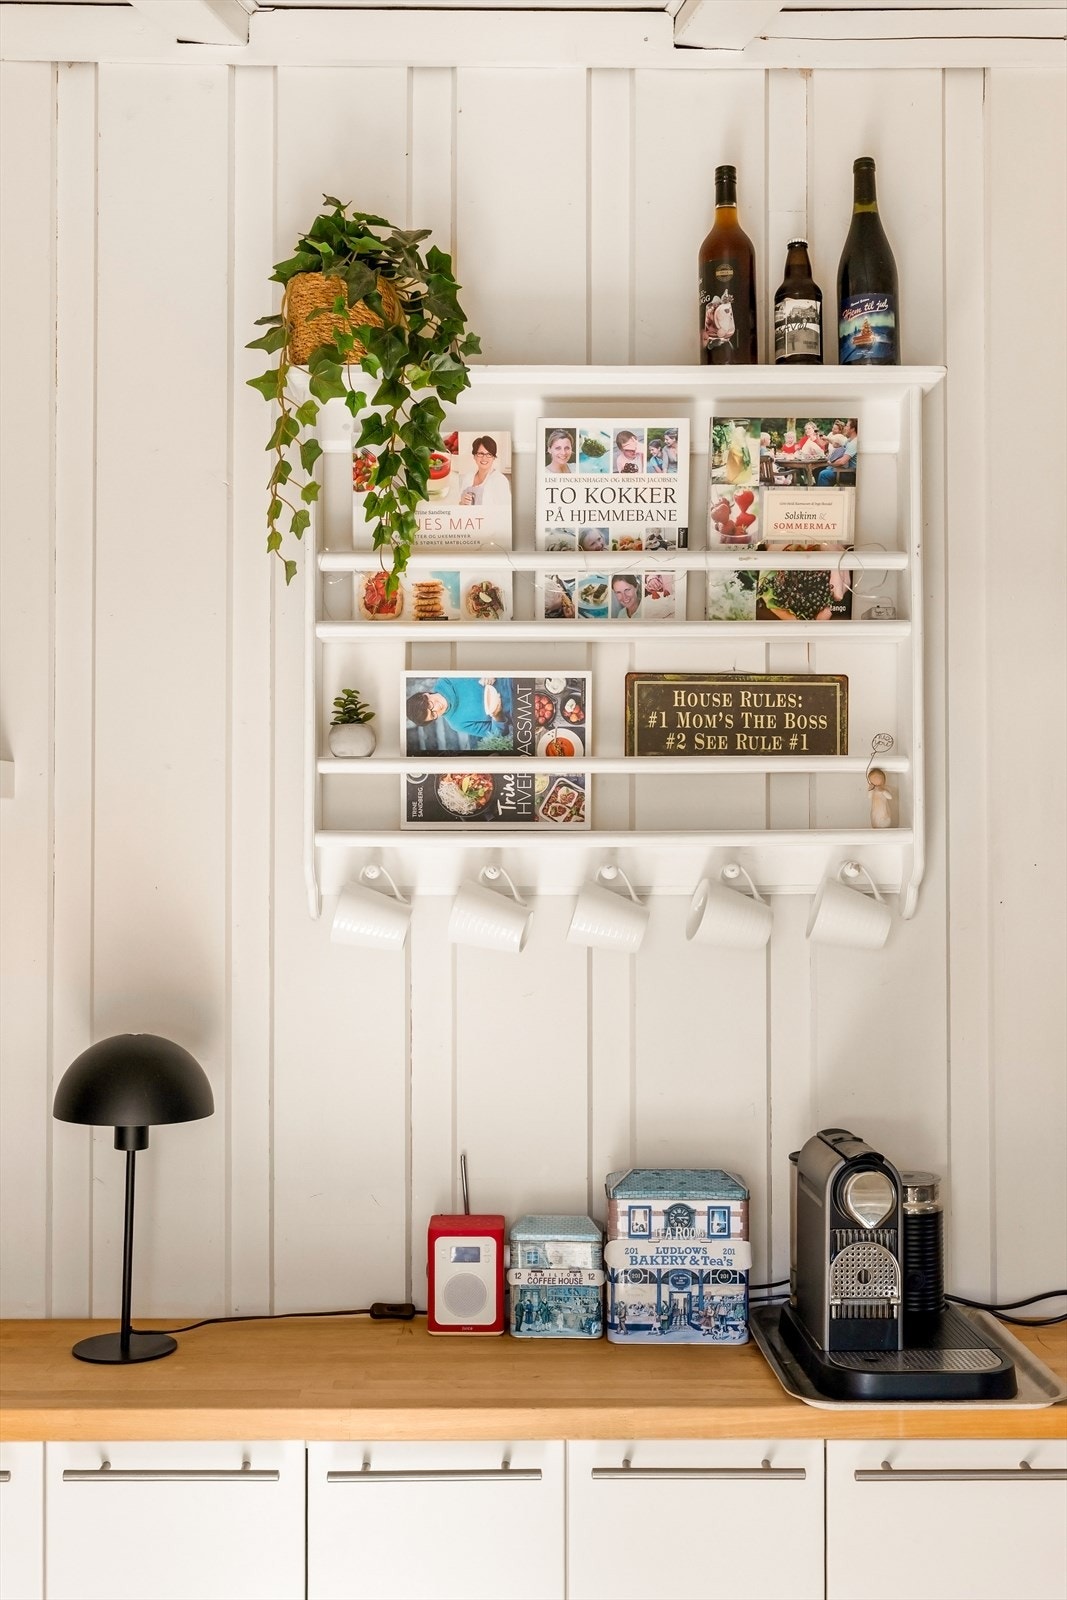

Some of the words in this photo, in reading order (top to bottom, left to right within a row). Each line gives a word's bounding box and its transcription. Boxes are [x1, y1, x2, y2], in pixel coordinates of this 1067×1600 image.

[864, 300, 874, 311] til
[545, 487, 577, 504] TO
[585, 487, 677, 504] KOKKER
[545, 506, 565, 521] PÅ
[570, 509, 678, 525] HJEMMEBANE
[785, 511, 817, 520] Solskinn
[449, 517, 484, 531] MAT
[773, 522, 837, 530] SOMMERMAT
[673, 690, 733, 708] HOUSE
[740, 690, 803, 708] RULES:
[648, 711, 668, 729] #1
[676, 711, 734, 730] MOM'S
[741, 712, 777, 730] THE
[783, 712, 828, 730] BOSS
[665, 732, 687, 750] #2
[694, 733, 728, 750] SEE
[735, 733, 782, 751] RULE
[789, 733, 809, 751] #1
[654, 1227, 672, 1240] TEA
[624, 1247, 639, 1255] 201
[655, 1246, 708, 1255] LUDLOWS
[722, 1248, 736, 1256] 201
[629, 1255, 688, 1266] BAKERY
[689, 1256, 700, 1266] &
[700, 1255, 733, 1267] Tea's
[514, 1272, 522, 1280] 12
[587, 1272, 596, 1281] 12
[527, 1277, 557, 1285] COFFEE
[558, 1277, 584, 1285] HOUSE
